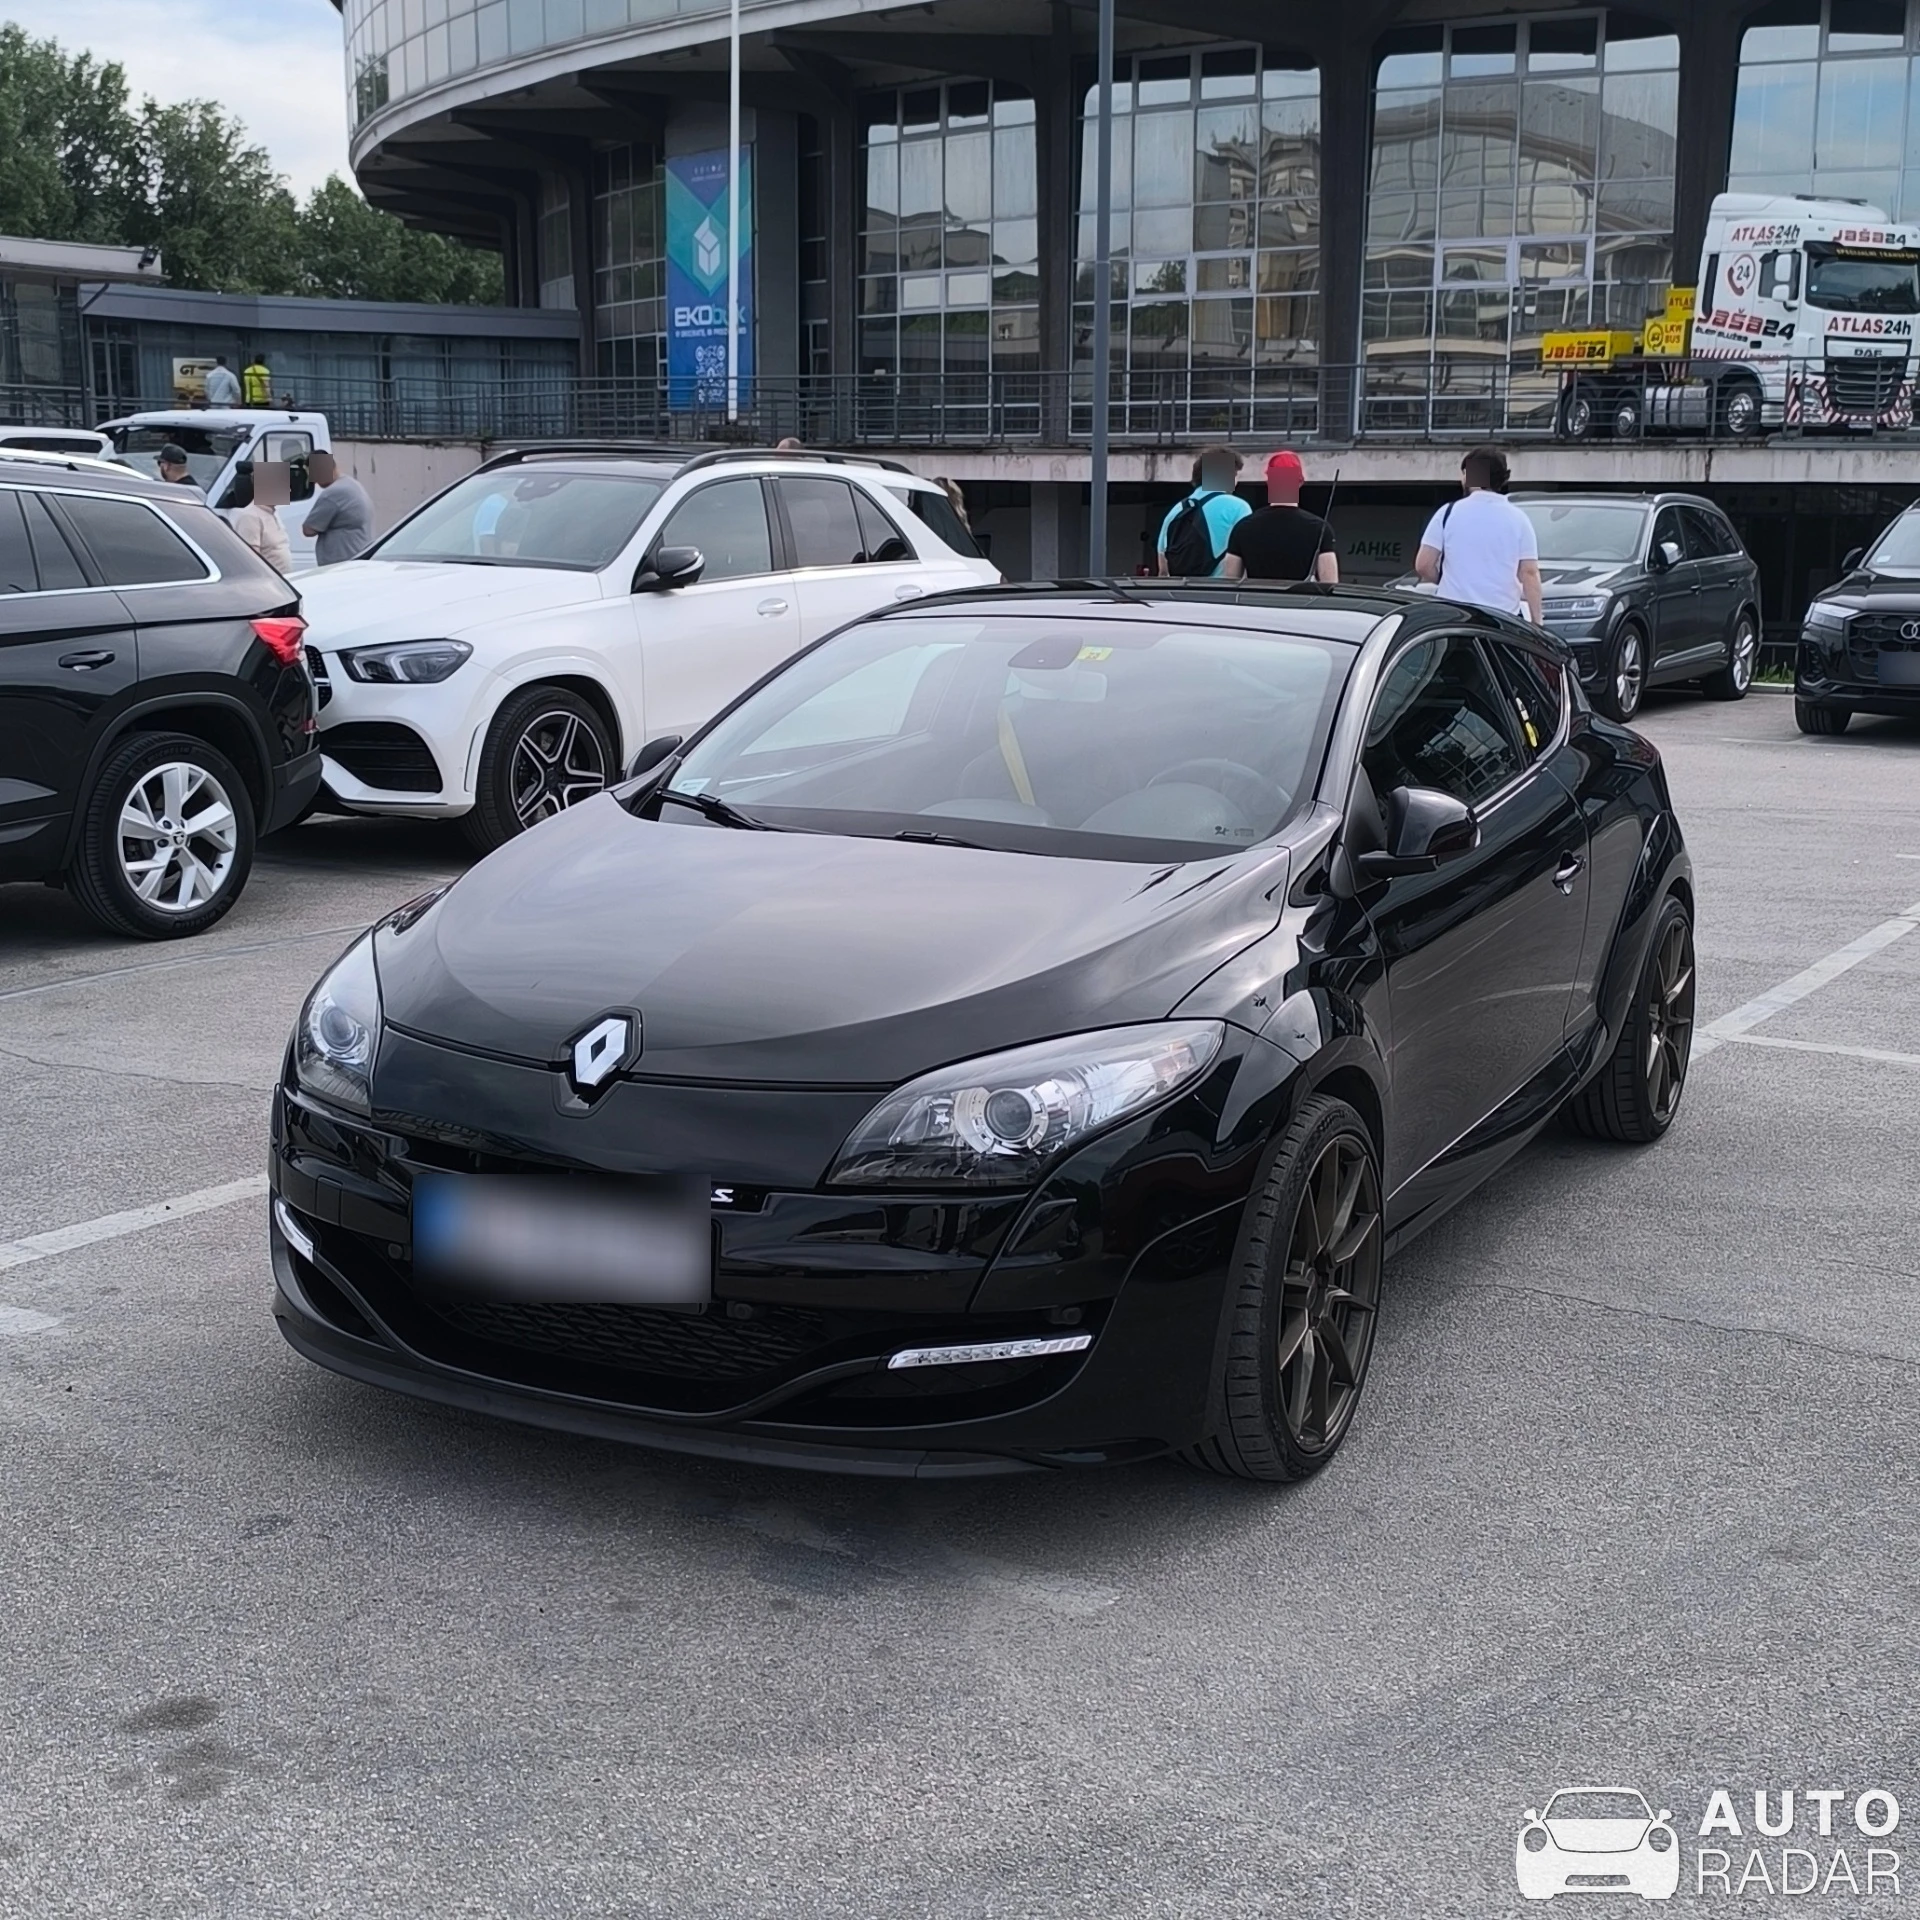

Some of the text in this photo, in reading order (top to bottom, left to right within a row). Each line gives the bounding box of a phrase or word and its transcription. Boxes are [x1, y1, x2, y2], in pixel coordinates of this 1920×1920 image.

[1731, 224, 1800, 242] ATLAS24h
[1736, 265, 1750, 281] 24
[1664, 324, 1682, 333] LKW
[1827, 317, 1911, 336] ATLAS24h
[1664, 334, 1681, 344] BUS
[179, 364, 197, 377] GT
[1346, 540, 1402, 557] JAHKE
[711, 1188, 735, 1203] S
